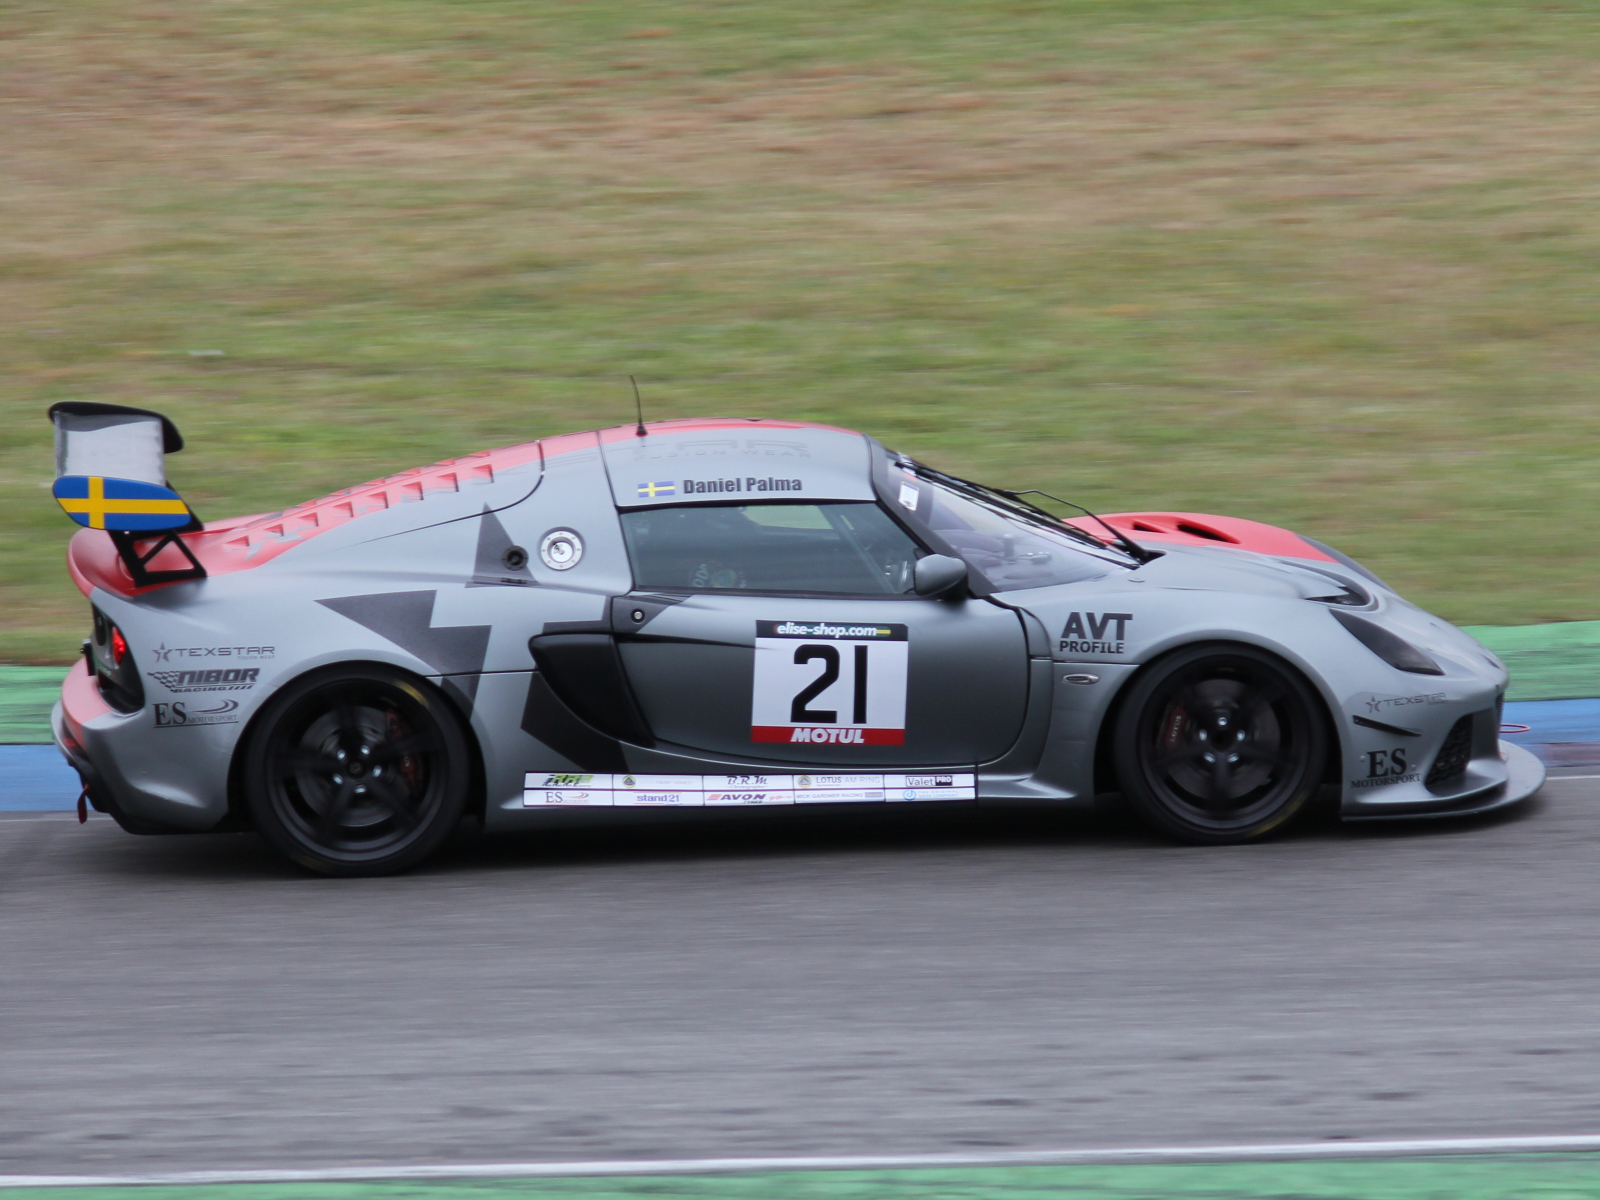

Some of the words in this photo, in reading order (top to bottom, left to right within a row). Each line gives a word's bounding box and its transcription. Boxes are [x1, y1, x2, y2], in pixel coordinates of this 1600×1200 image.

[683, 478, 742, 494] Daniel
[746, 477, 803, 492] Palma
[776, 622, 877, 638] elise-shop.com
[1061, 612, 1133, 641] AVT
[174, 646, 275, 657] TEXSTAR
[1059, 640, 1124, 654] PROFILE
[177, 668, 260, 685] NIBOR
[790, 644, 868, 724] 21
[153, 701, 187, 726] ES
[187, 715, 238, 725] MOTORSPORT
[790, 728, 865, 744] MOTUL
[1366, 747, 1408, 779] ES
[816, 776, 842, 784] LOTUS
[844, 776, 858, 784] AM
[860, 776, 880, 784] RING
[907, 777, 934, 787] Valet
[1350, 773, 1422, 789] MOTORSPORT
[545, 791, 563, 803] ES
[720, 793, 767, 801] AVON
